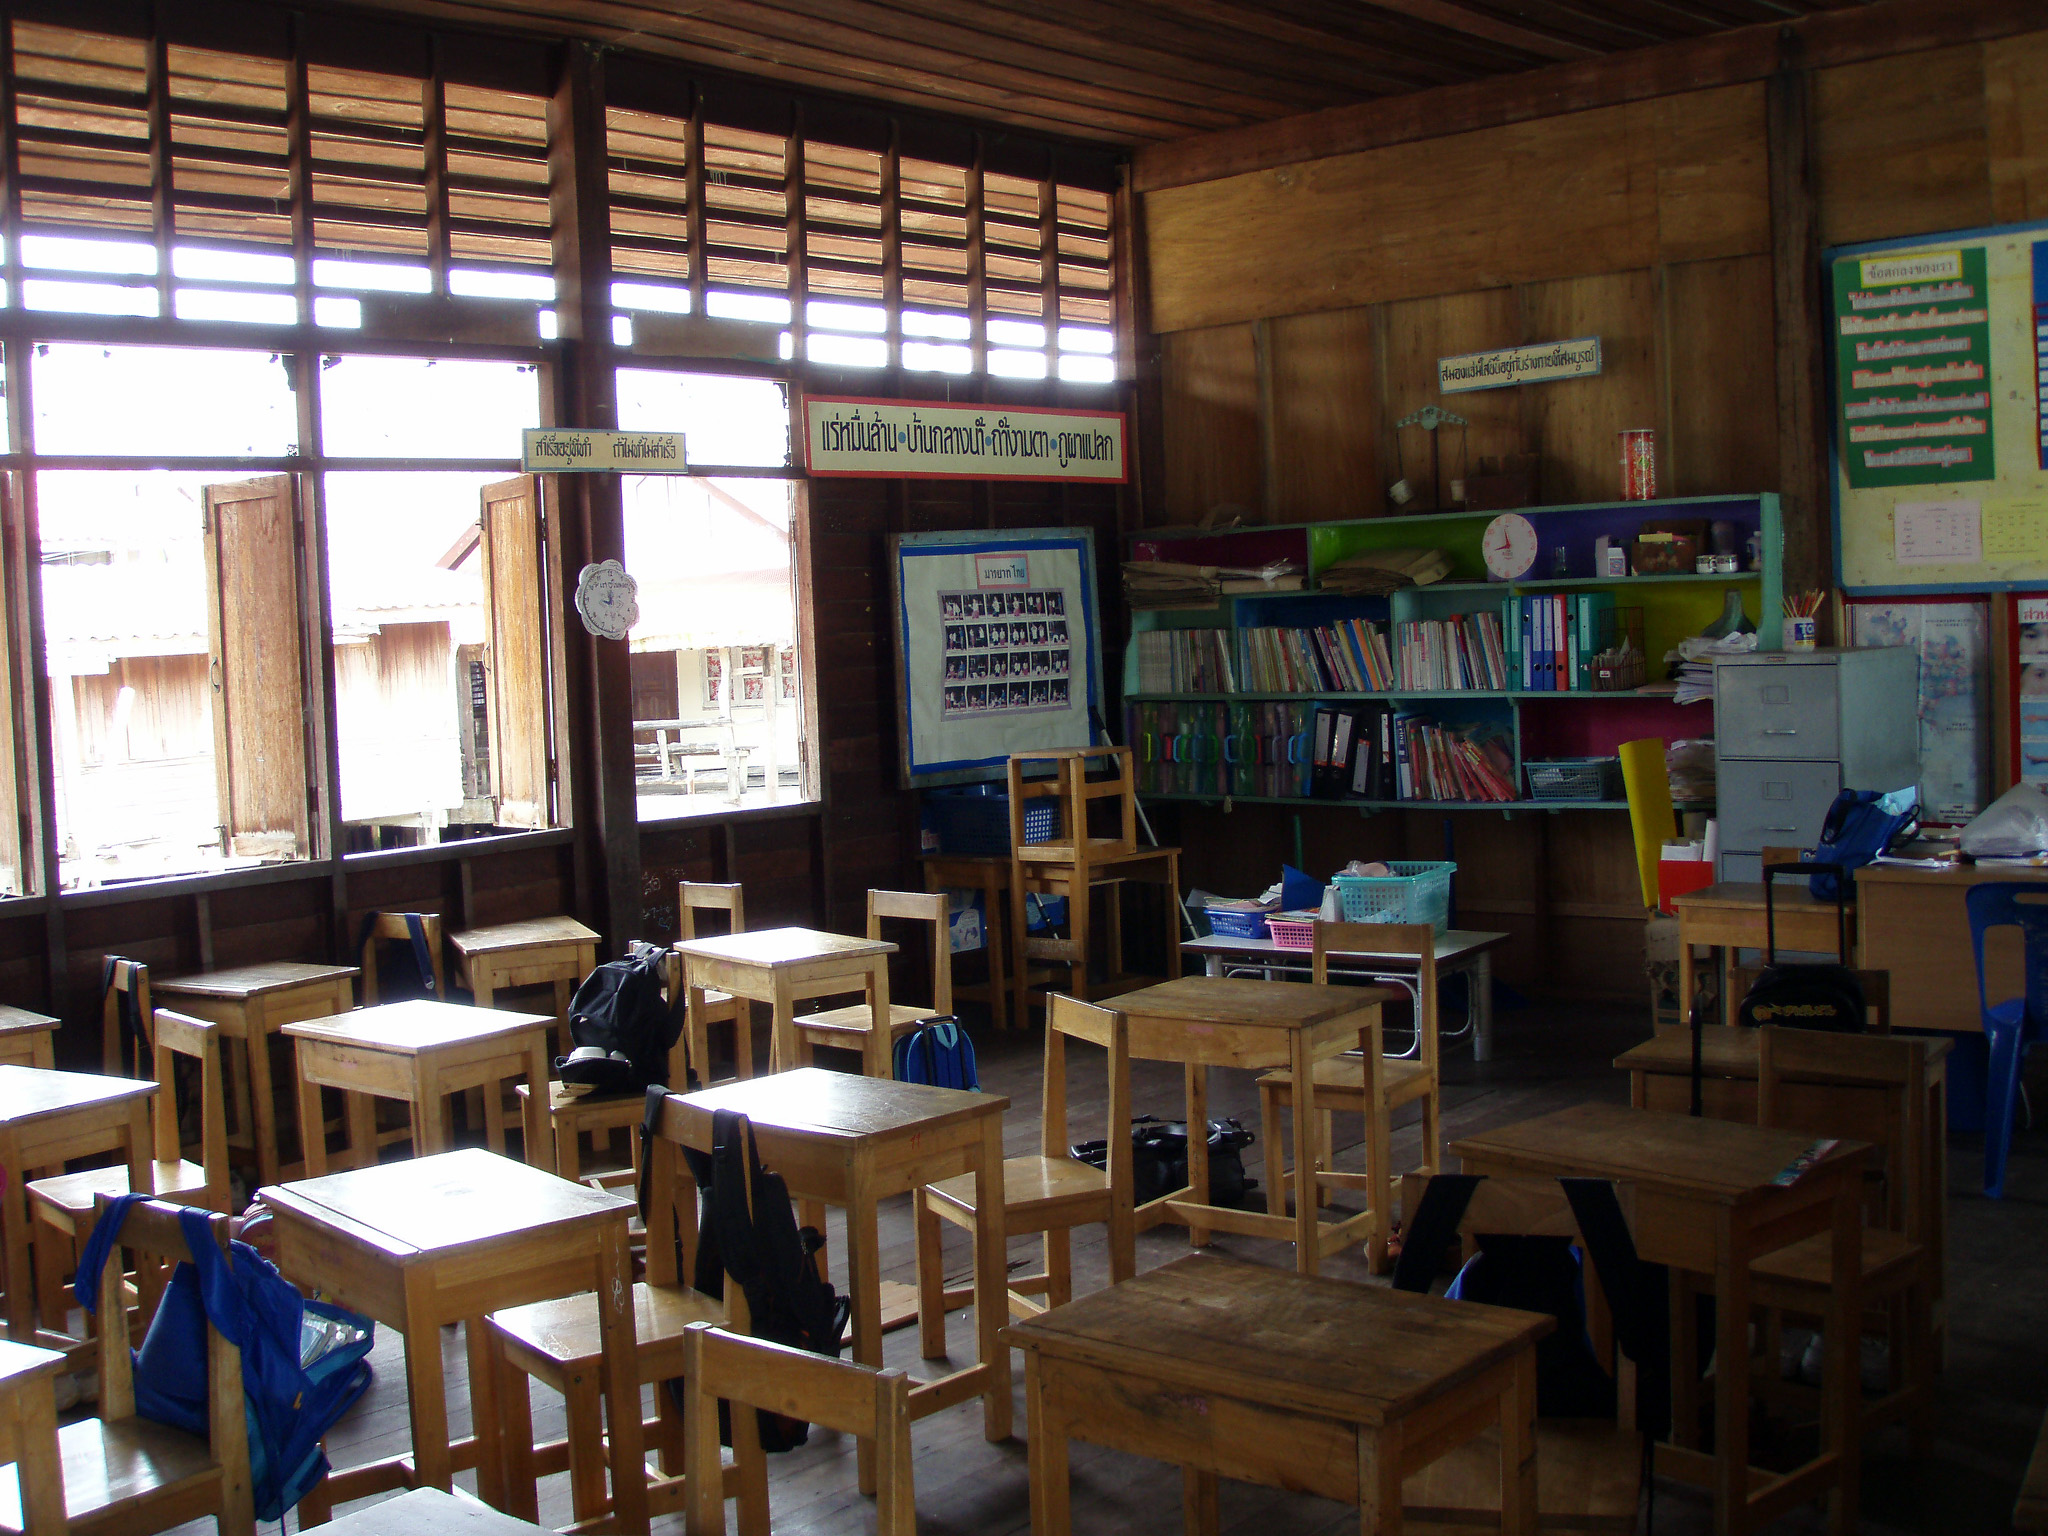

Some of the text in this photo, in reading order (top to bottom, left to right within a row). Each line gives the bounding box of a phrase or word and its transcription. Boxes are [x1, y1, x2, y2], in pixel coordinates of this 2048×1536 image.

[821, 408, 1114, 468] แร่หมื่นล้าน บ้านกลางน้ำ ถ้ำงามตา ภูผาแปลก
